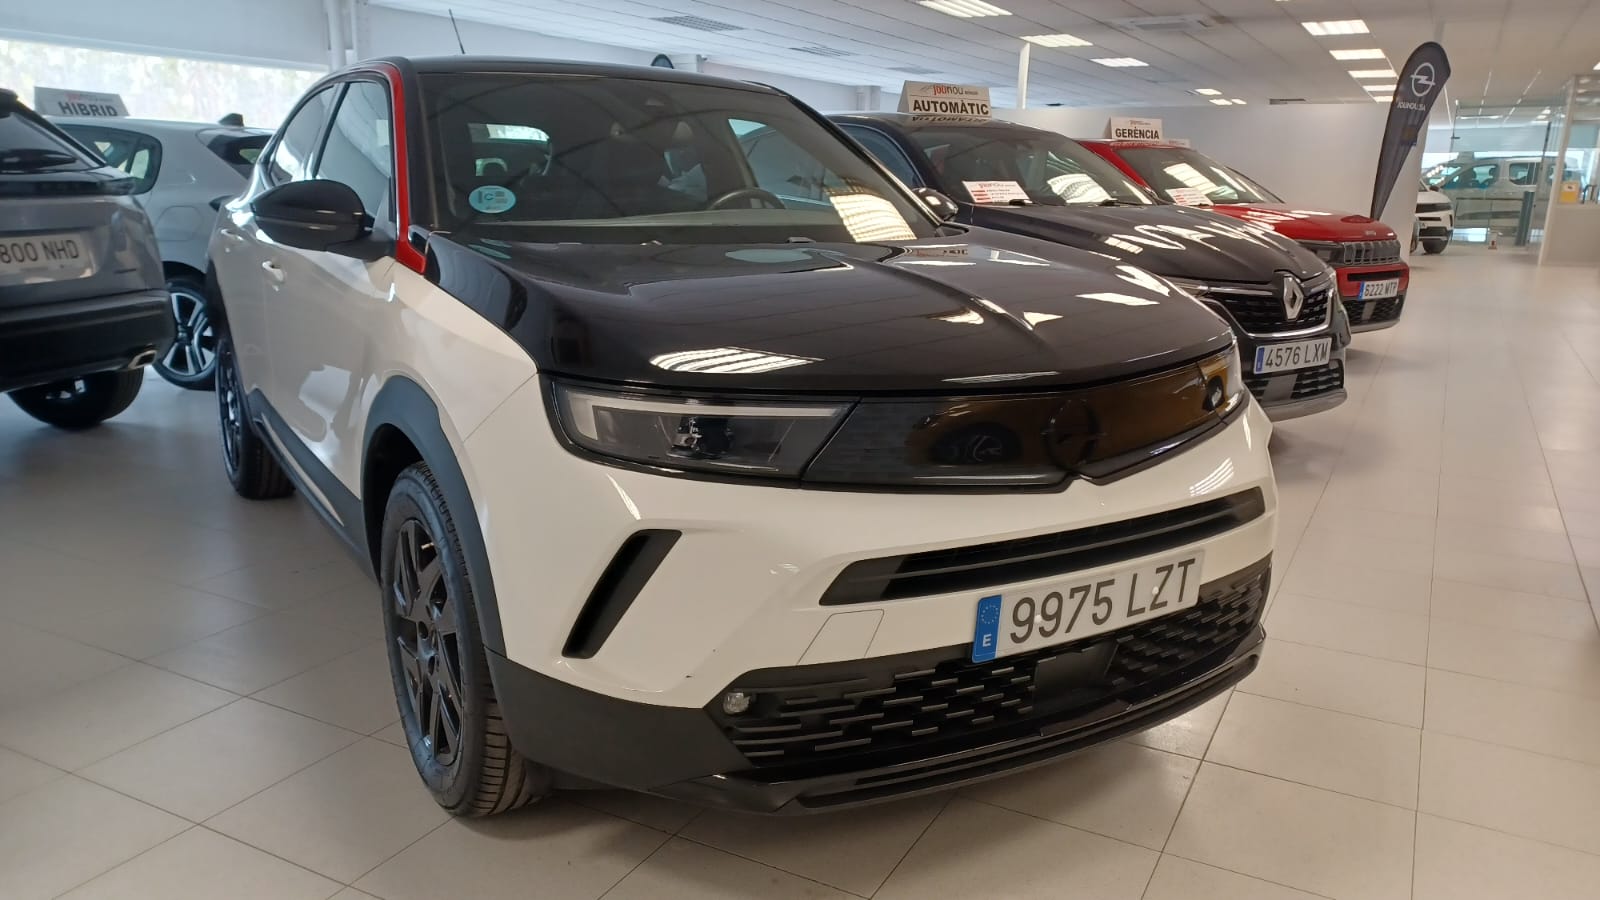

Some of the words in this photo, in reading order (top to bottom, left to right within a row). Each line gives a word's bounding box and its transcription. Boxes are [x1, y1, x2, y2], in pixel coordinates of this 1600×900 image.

[913, 99, 989, 115] AUTOMÀTIC
[1115, 126, 1160, 139] GERÈNCIA
[40, 239, 79, 261] NHD
[1364, 283, 1384, 297] 6222
[1265, 346, 1301, 368] 4576
[1304, 341, 1329, 363] LXM
[982, 633, 991, 647] E
[1009, 578, 1116, 645] 9975
[1126, 558, 1196, 618] LZT
